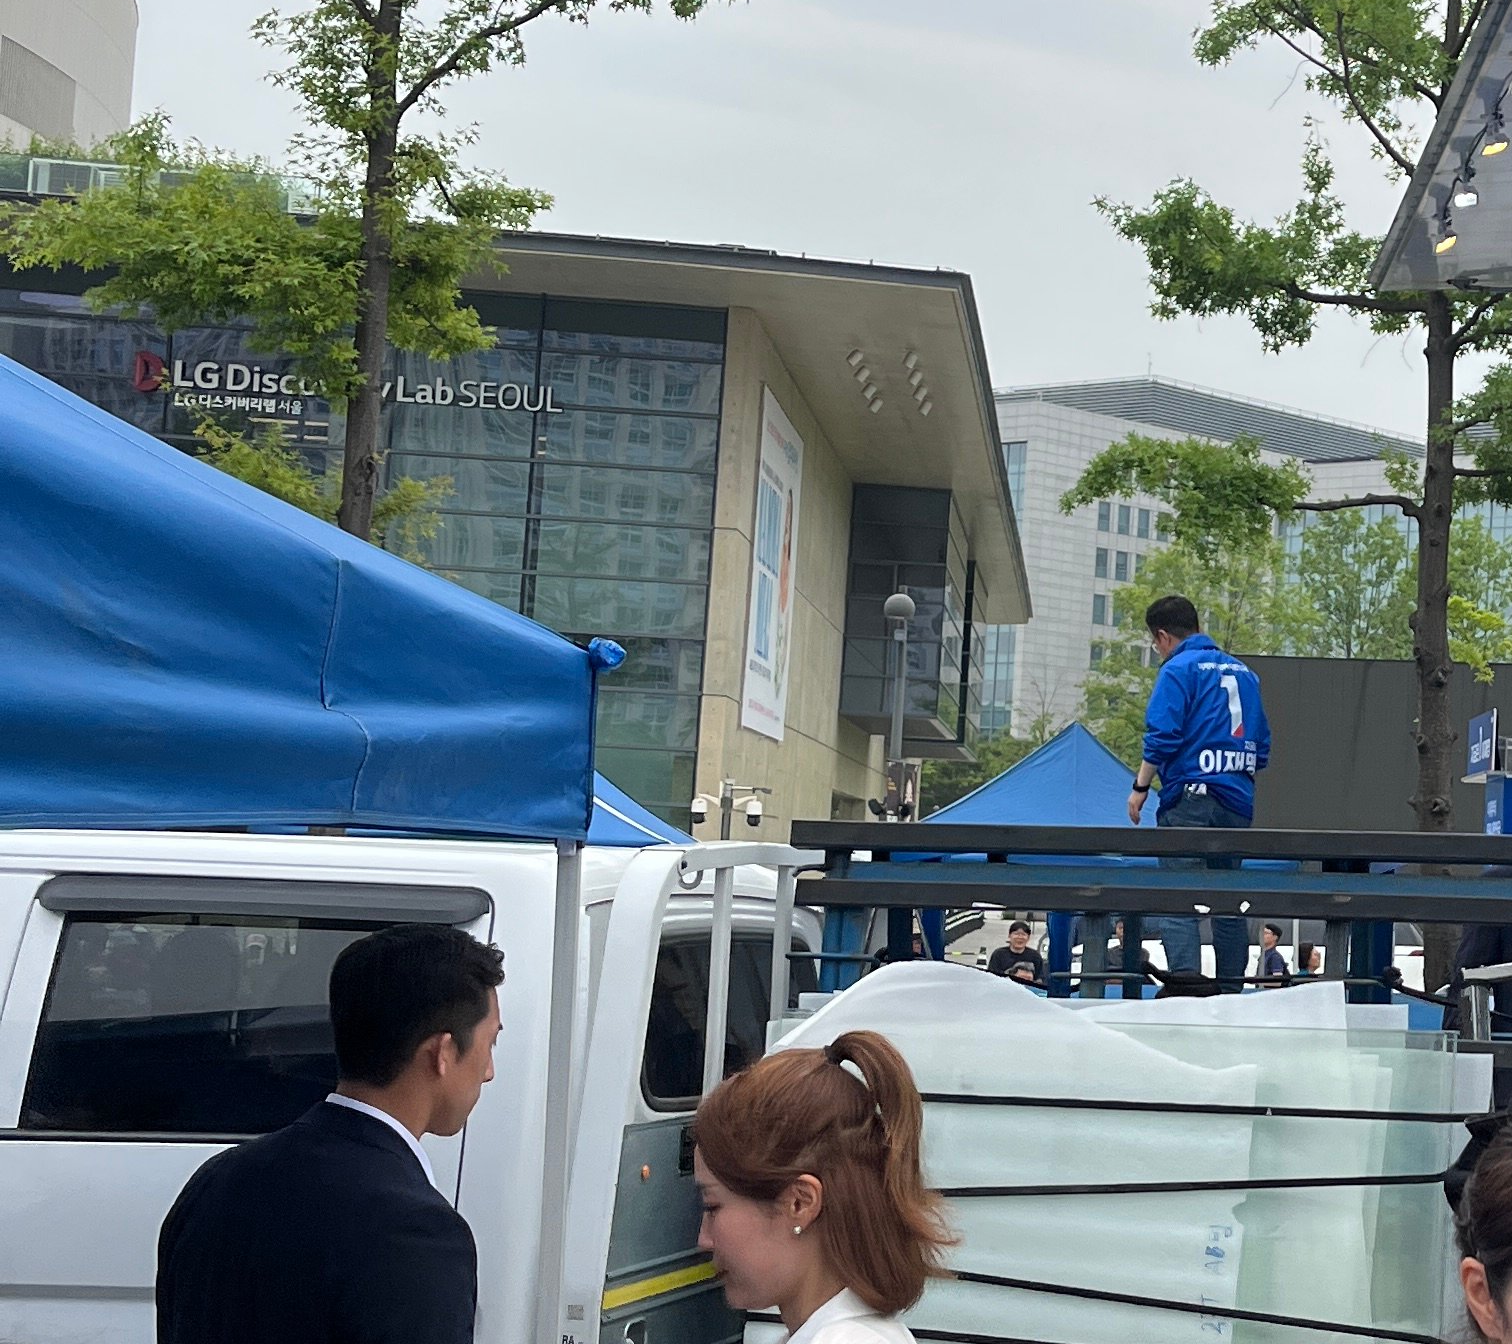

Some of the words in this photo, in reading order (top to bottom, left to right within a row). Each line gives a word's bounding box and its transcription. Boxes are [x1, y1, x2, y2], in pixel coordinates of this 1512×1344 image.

[173, 359, 220, 389] LG
[396, 375, 454, 405] Lab
[458, 380, 563, 413] SEOUL
[278, 399, 302, 415] 서울
[1220, 675, 1243, 737] 1
